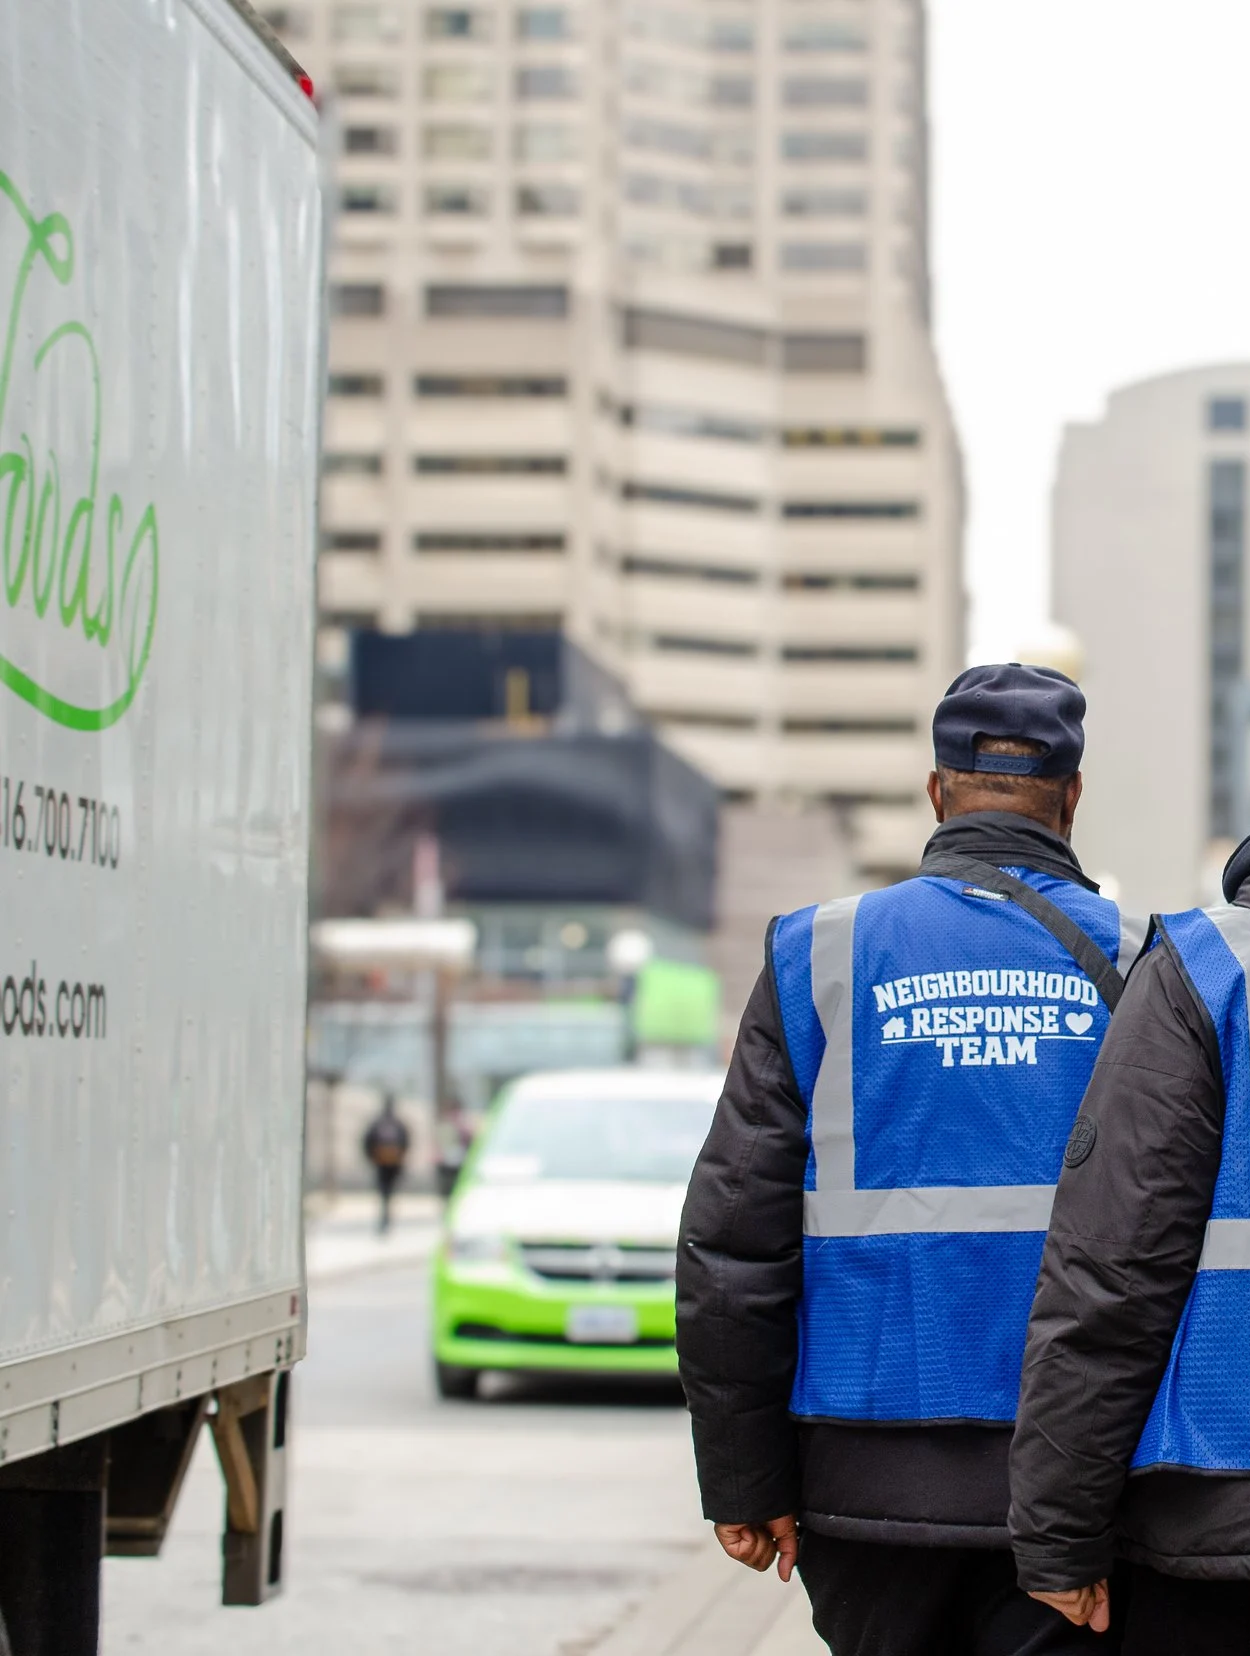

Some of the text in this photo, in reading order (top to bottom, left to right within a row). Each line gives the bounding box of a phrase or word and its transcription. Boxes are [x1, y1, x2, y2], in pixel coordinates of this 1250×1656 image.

[0, 776, 120, 870] 16.700.7100
[0, 959, 106, 1039] ods.com
[872, 969, 1099, 1013] NEIGHBOURHOOD
[911, 1005, 1060, 1037] RESPONSE
[936, 1035, 1038, 1067] TEAM
